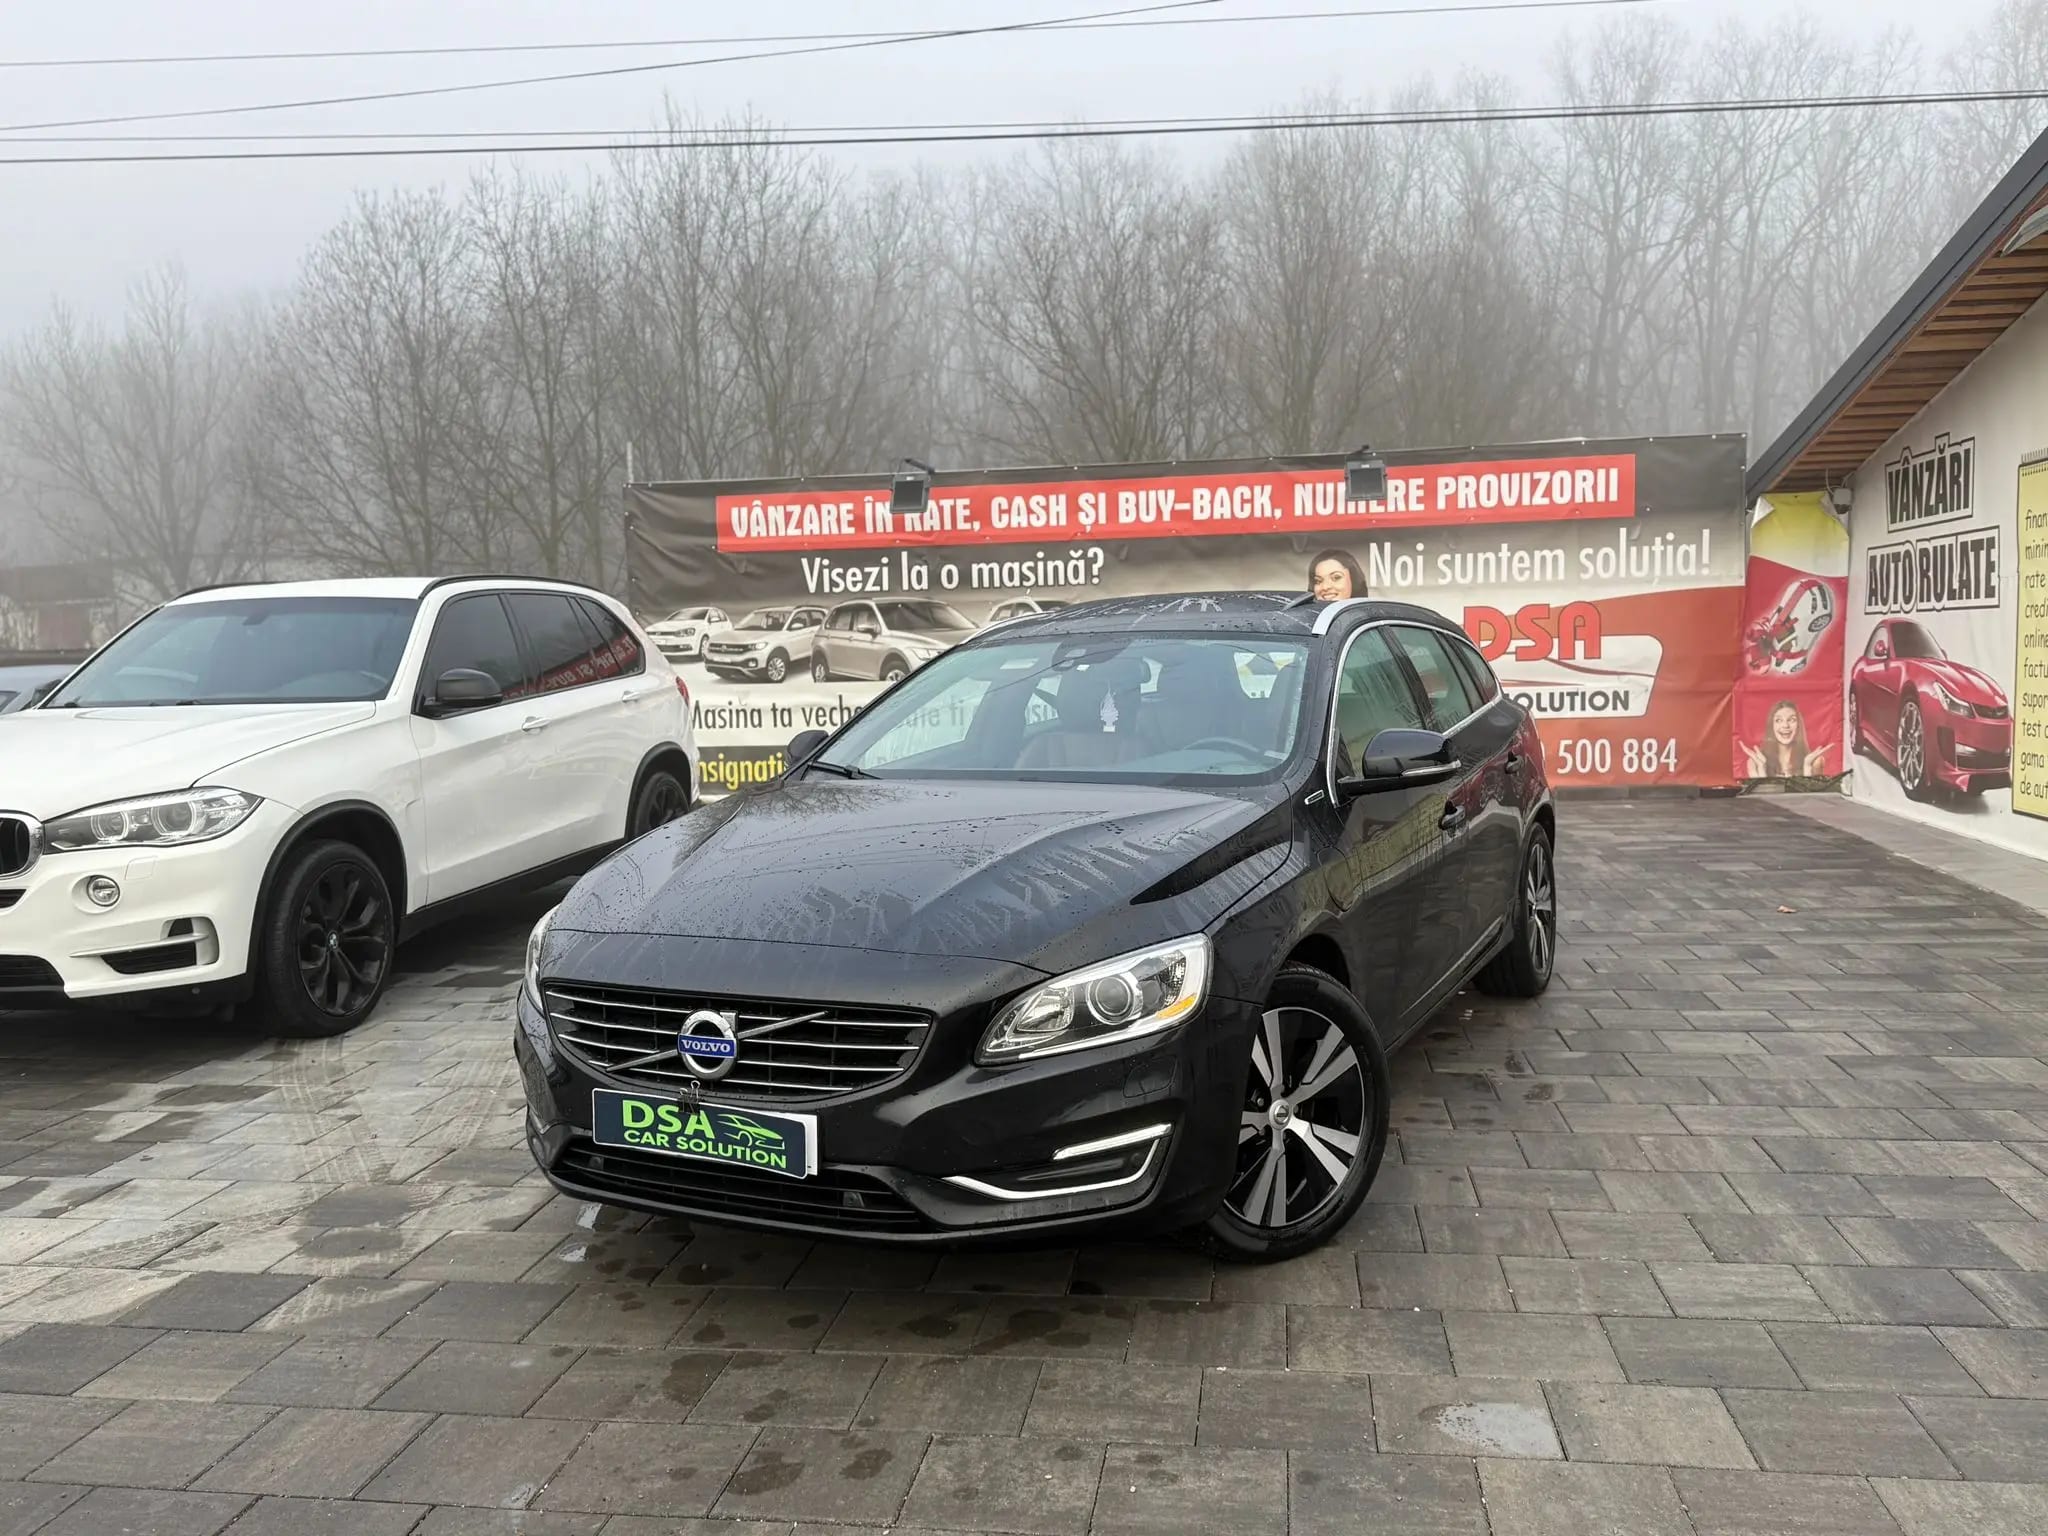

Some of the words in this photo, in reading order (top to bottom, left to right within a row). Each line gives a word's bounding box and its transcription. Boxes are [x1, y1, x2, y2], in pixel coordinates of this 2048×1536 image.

[731, 500, 855, 538] VÂNZARE
[864, 496, 893, 533] ÎN
[904, 498, 981, 532] RATE,
[991, 494, 1067, 528] CASH
[1078, 492, 1106, 533] ȘI
[1118, 485, 1282, 523] BUY-BACK,
[1437, 467, 1619, 510] PROVIZORII
[1888, 443, 1970, 524] VÂNZĂRI
[801, 557, 889, 593] Visezi
[901, 551, 929, 591] la
[941, 563, 959, 589] o
[972, 547, 1105, 594] mașină?
[1369, 542, 1424, 586] Noi
[1438, 543, 1565, 585] suntem
[1580, 527, 1711, 585] soluția!
[1868, 549, 1915, 607] AUTO
[1918, 537, 1996, 603] RULATE
[2025, 572, 2046, 589] rate
[1464, 601, 1601, 662] DSA
[771, 703, 792, 728] ta
[1504, 690, 1630, 712] OLUTION
[2022, 718, 2041, 737] test
[1557, 738, 1611, 774] 500
[1623, 738, 1677, 774] 884
[2020, 751, 2044, 771] gama
[2020, 775, 2031, 795] de
[681, 1039, 731, 1053] VOLVO
[622, 1099, 715, 1139] DSA
[623, 1128, 670, 1148] CAR
[676, 1136, 786, 1168] SOLUTION
